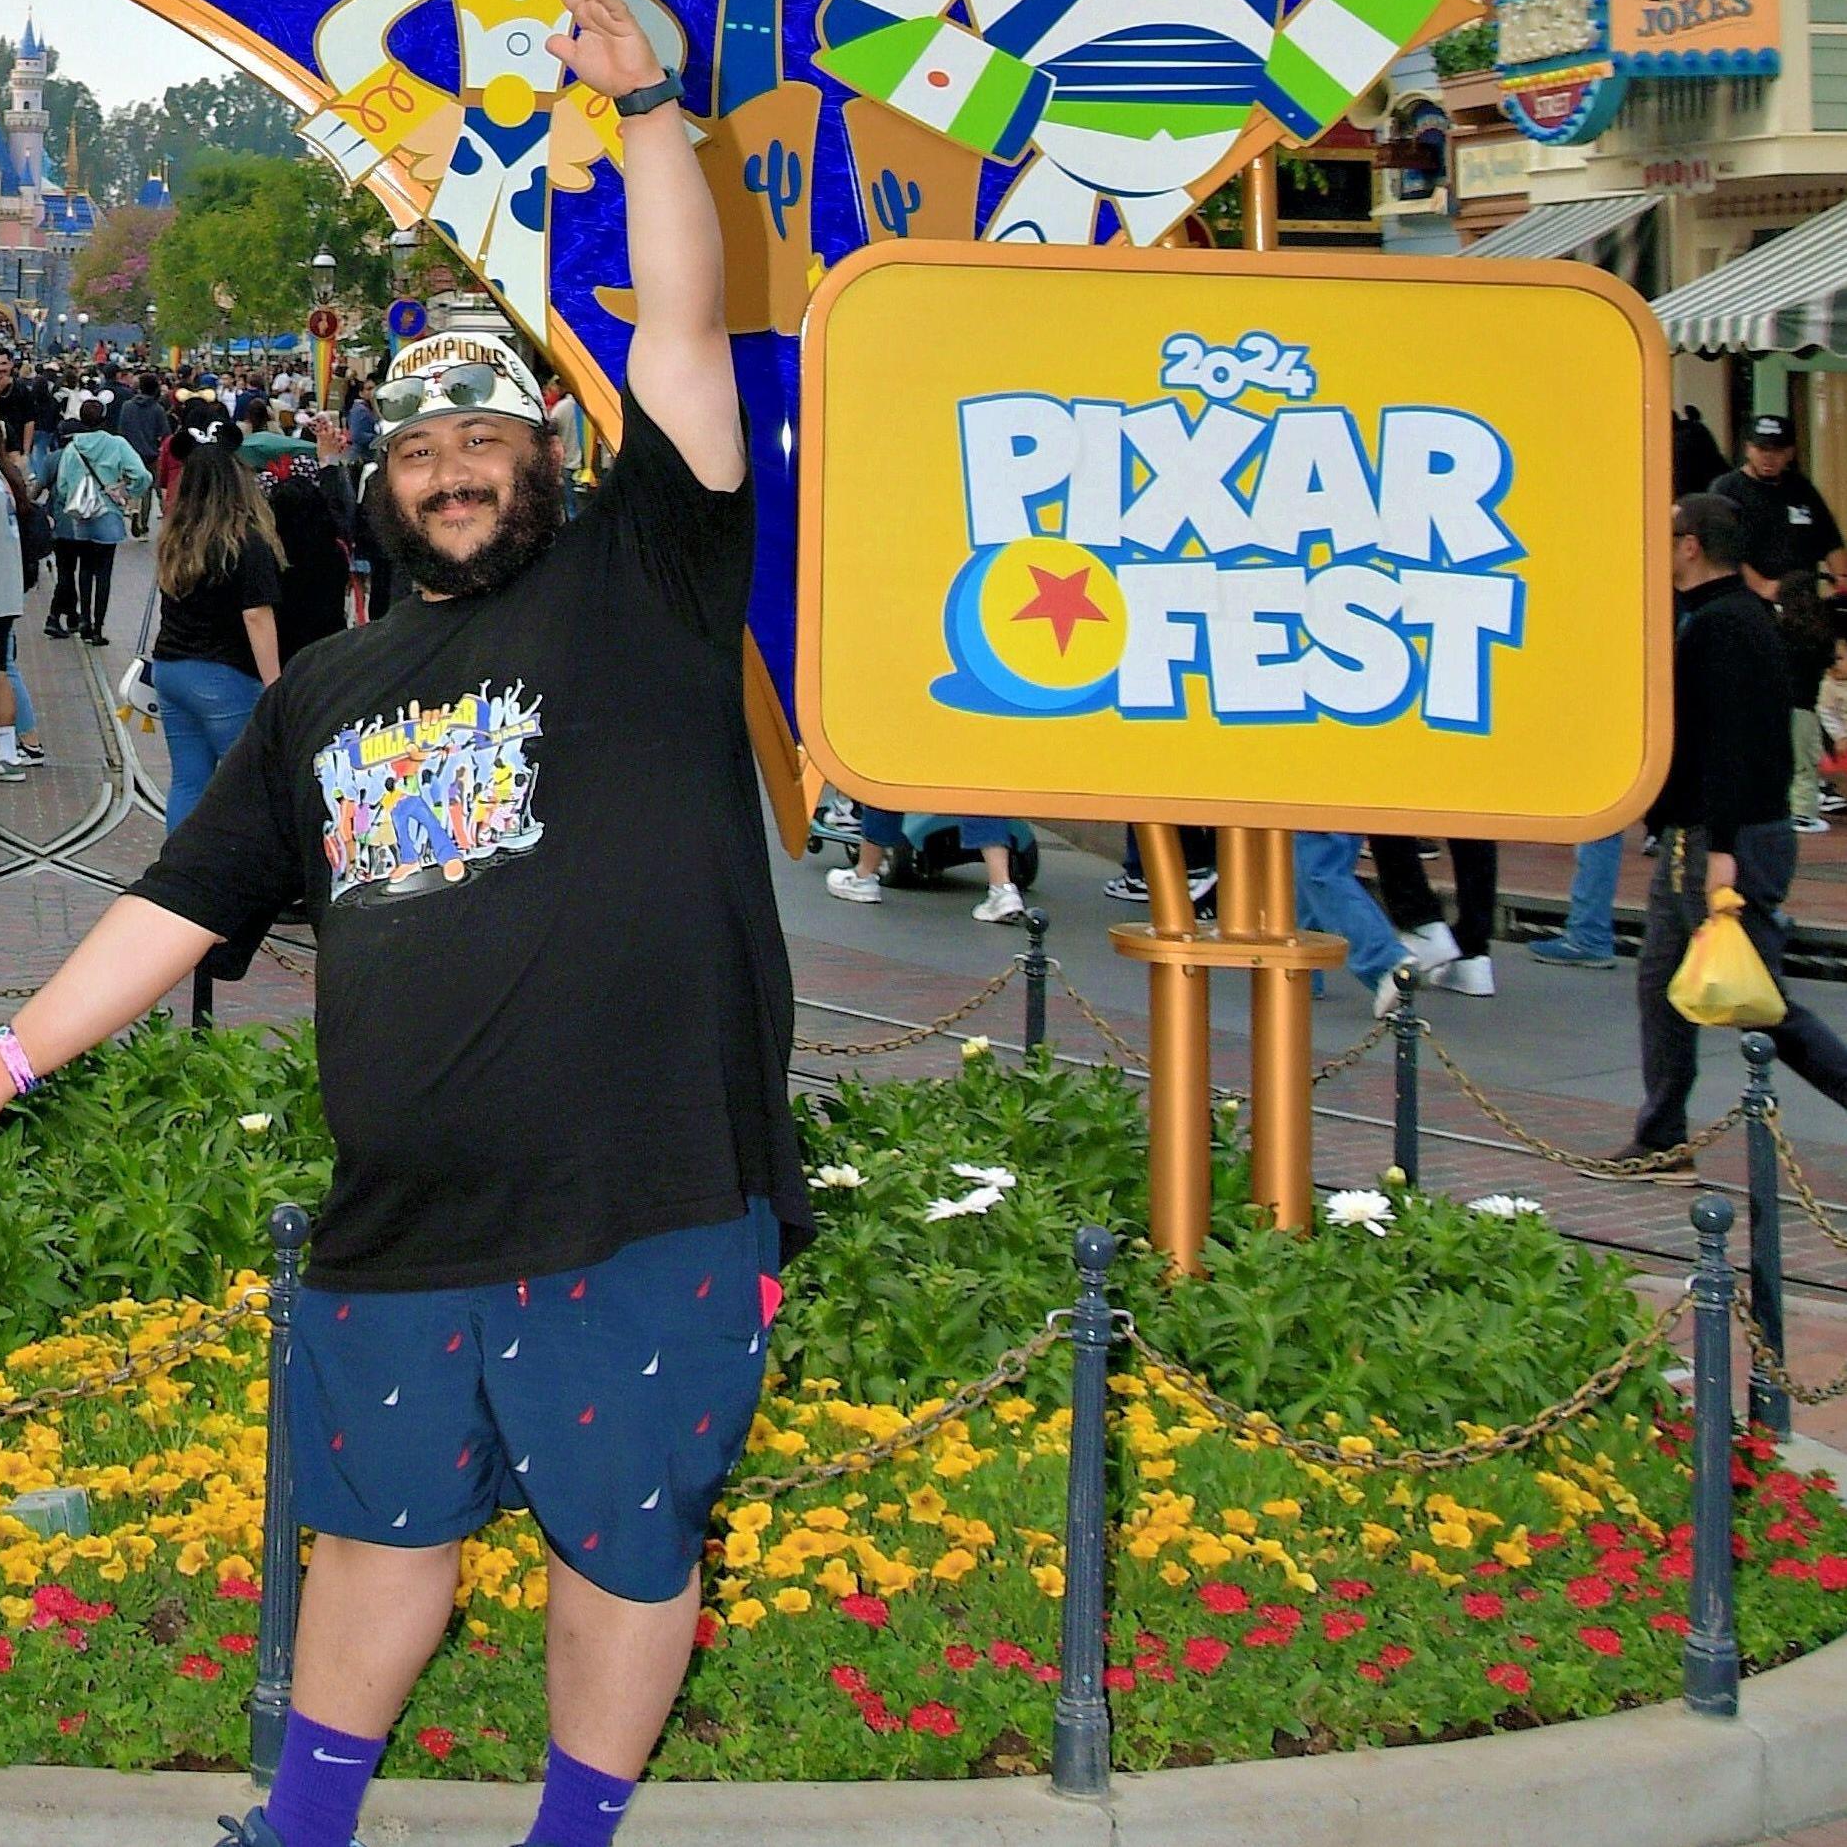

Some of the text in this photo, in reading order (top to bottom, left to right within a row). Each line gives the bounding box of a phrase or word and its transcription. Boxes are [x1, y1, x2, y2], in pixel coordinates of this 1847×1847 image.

[392, 338, 507, 380] CHAMPIONS
[1161, 332, 1315, 399] 2024
[958, 393, 1526, 566] PIXAR
[1116, 561, 1525, 734] FEST
